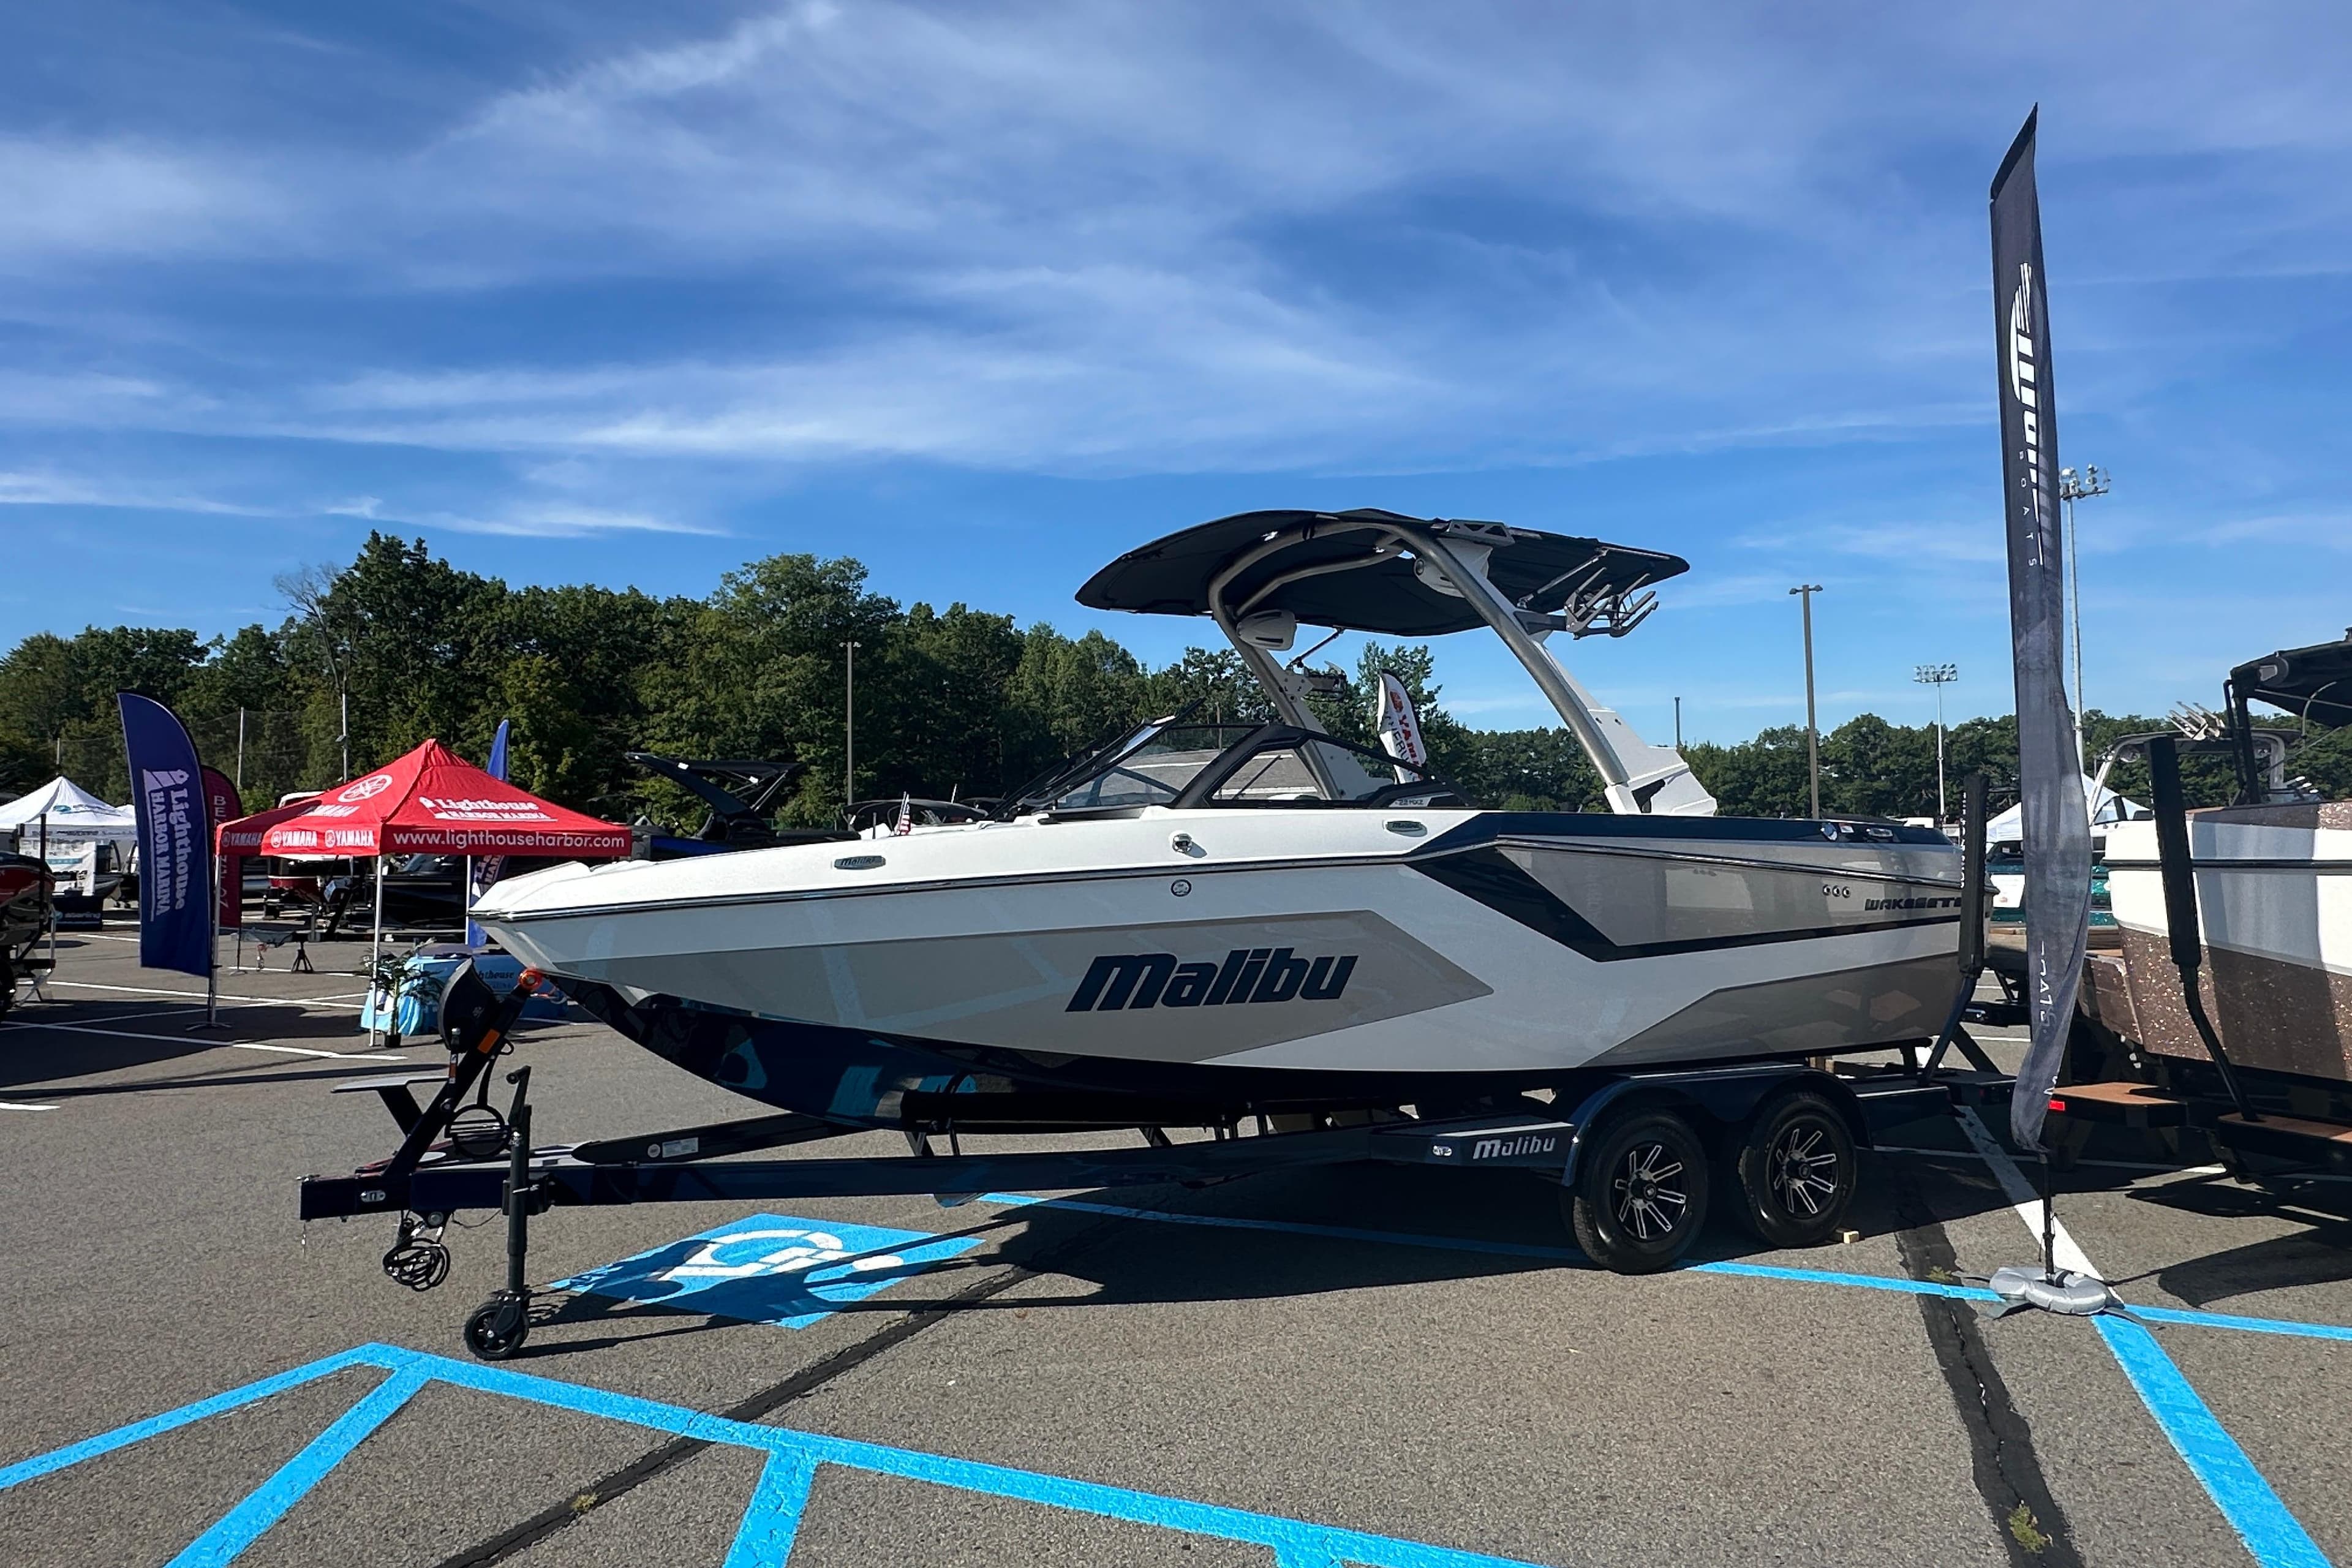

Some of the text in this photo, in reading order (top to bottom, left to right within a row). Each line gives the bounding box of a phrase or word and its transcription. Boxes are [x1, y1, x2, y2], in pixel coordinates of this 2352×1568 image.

[434, 799, 539, 811] Lighthouse
[169, 788, 192, 910] Lighthouse
[282, 831, 317, 847] YAMAHA
[337, 830, 375, 847] YAMAHA
[393, 829, 625, 850] www.lighthouseharbor.com
[151, 791, 171, 916] HARBOR MARINA
[1065, 947, 1359, 1012] Malibu
[1472, 1136, 1556, 1159] Malibu
